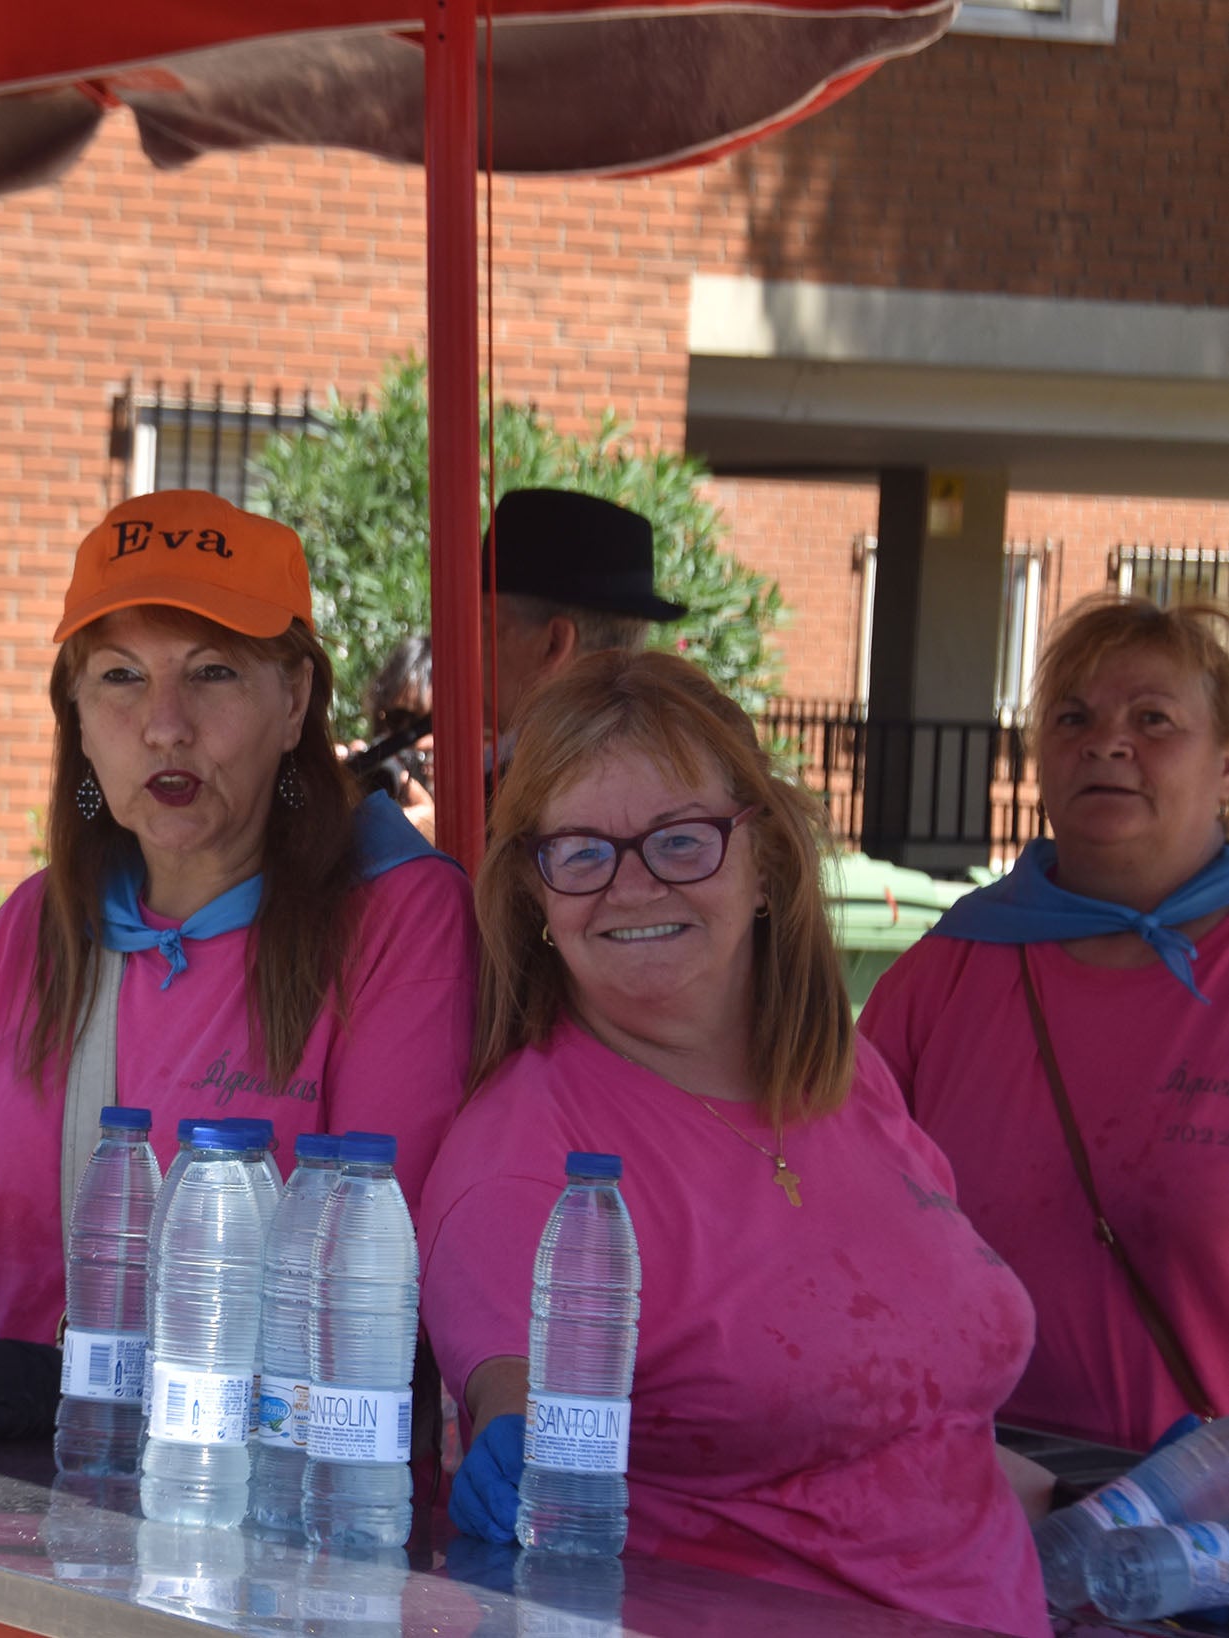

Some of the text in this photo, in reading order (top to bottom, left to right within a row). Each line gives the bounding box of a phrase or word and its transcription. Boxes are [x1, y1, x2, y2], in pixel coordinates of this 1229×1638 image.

[109, 520, 233, 561] Eva
[189, 1049, 319, 1107] Águeas
[309, 1395, 378, 1428] ANTOLÍN
[536, 1404, 621, 1439] SANTOLÍN
